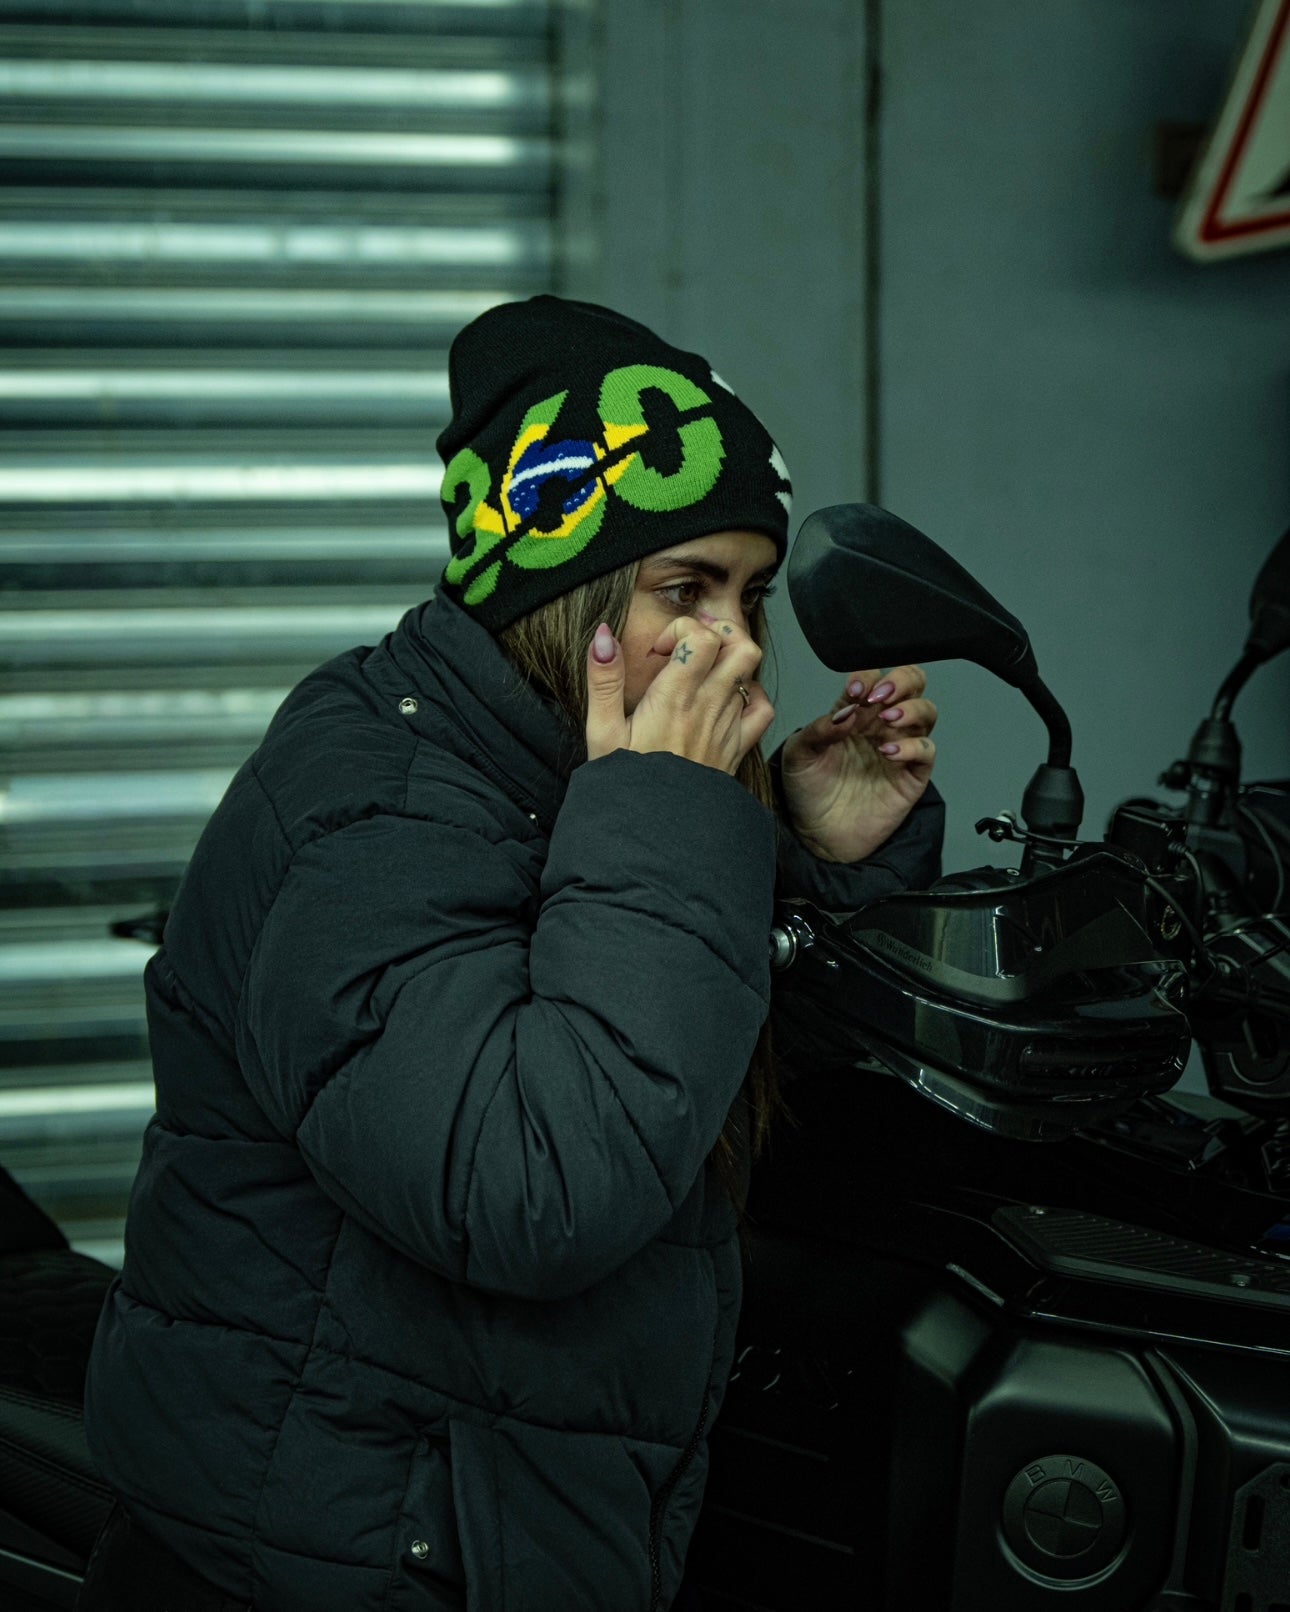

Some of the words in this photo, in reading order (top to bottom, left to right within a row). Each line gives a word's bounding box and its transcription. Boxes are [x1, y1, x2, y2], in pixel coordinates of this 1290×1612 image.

[442, 364, 726, 606] 360
[887, 939, 934, 972] Wunderlich
[1025, 1459, 1117, 1503] BMW
